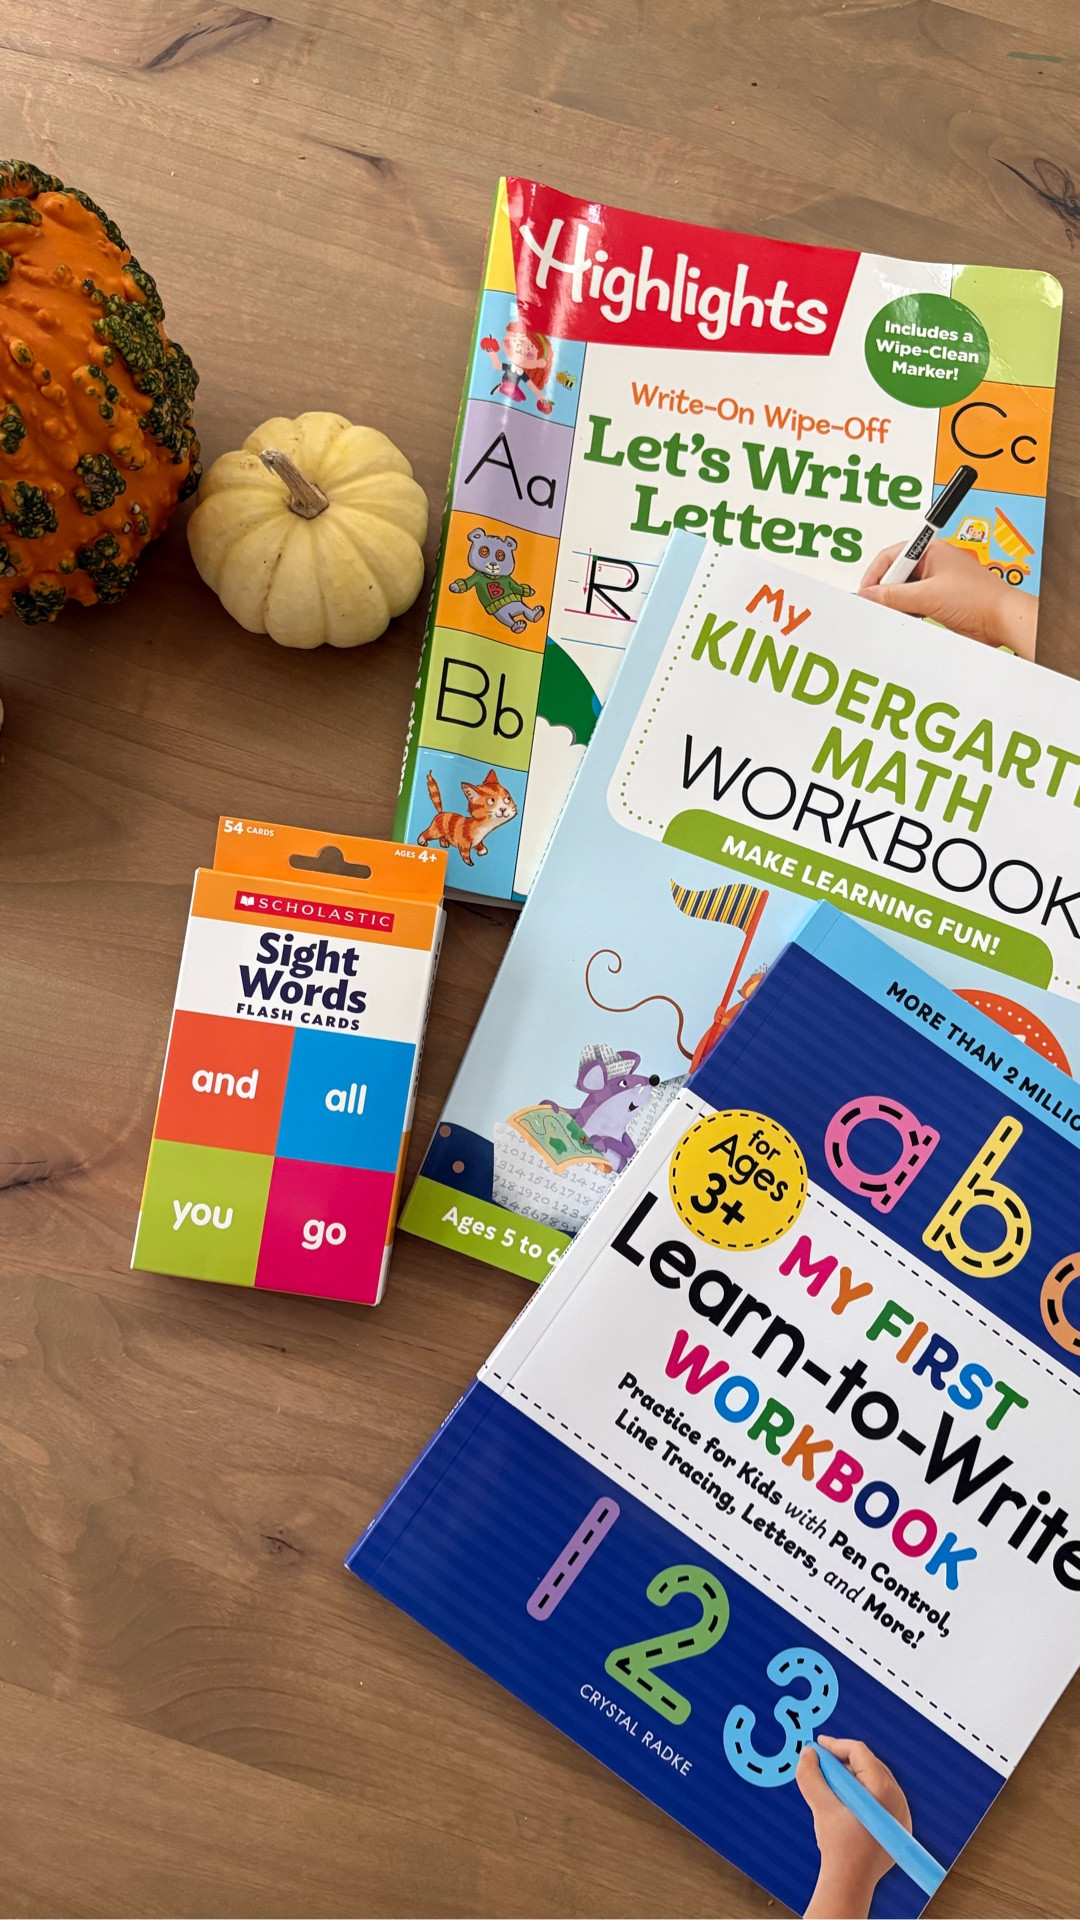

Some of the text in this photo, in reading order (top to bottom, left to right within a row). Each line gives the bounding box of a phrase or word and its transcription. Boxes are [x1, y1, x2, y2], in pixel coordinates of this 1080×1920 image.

[519, 217, 828, 340] Highlights
[875, 338, 979, 364] Wipe-Clean
[884, 319, 974, 343] Includes a
[892, 360, 959, 381] Marker!
[631, 381, 892, 444] Write-On Wipe-Off
[951, 402, 1038, 464] Cc
[464, 432, 556, 509] Aa
[748, 442, 922, 511] Write
[630, 484, 863, 563] Letters
[487, 582, 504, 599] B
[586, 555, 640, 620] R
[745, 584, 812, 636] My
[436, 657, 523, 739] Bb
[690, 612, 1080, 809] KINDERGART
[811, 726, 993, 832] MATH
[223, 820, 274, 837] 54 CARDS
[394, 848, 437, 863] AGES 4+
[682, 734, 1080, 940] WORKBOOK
[258, 898, 391, 927] SCHOLASTIC
[721, 835, 1000, 956] MAKE LEARNING FUN!
[256, 932, 359, 979] Sight
[236, 1003, 360, 1031] FLASH CARDS
[239, 965, 367, 1014] Words
[886, 982, 947, 1032] MORE
[948, 1022, 1005, 1073] THAN
[1003, 1066, 1019, 1085] 2
[192, 1068, 259, 1100] and
[325, 1083, 367, 1115] all
[709, 1133, 789, 1202] Ages
[749, 1130, 781, 1162] for
[173, 1200, 233, 1230] you
[690, 1173, 746, 1227] 3+
[824, 1096, 940, 1213] a
[922, 1115, 1032, 1278] b
[301, 1218, 346, 1250] go
[441, 1207, 561, 1266] Ages 5 to 6
[779, 1235, 1029, 1431] MY FIRST
[610, 1191, 1080, 1592] Learn-to-Write
[664, 1329, 977, 1590] WORKBOOK
[615, 1409, 925, 1649] Line Tracing, Letters, and More!
[617, 1372, 951, 1637] Practice for Kids with Pen Control,
[526, 1497, 839, 1787] 1 2 3
[579, 1683, 693, 1777] CRYSTAL RADKE
